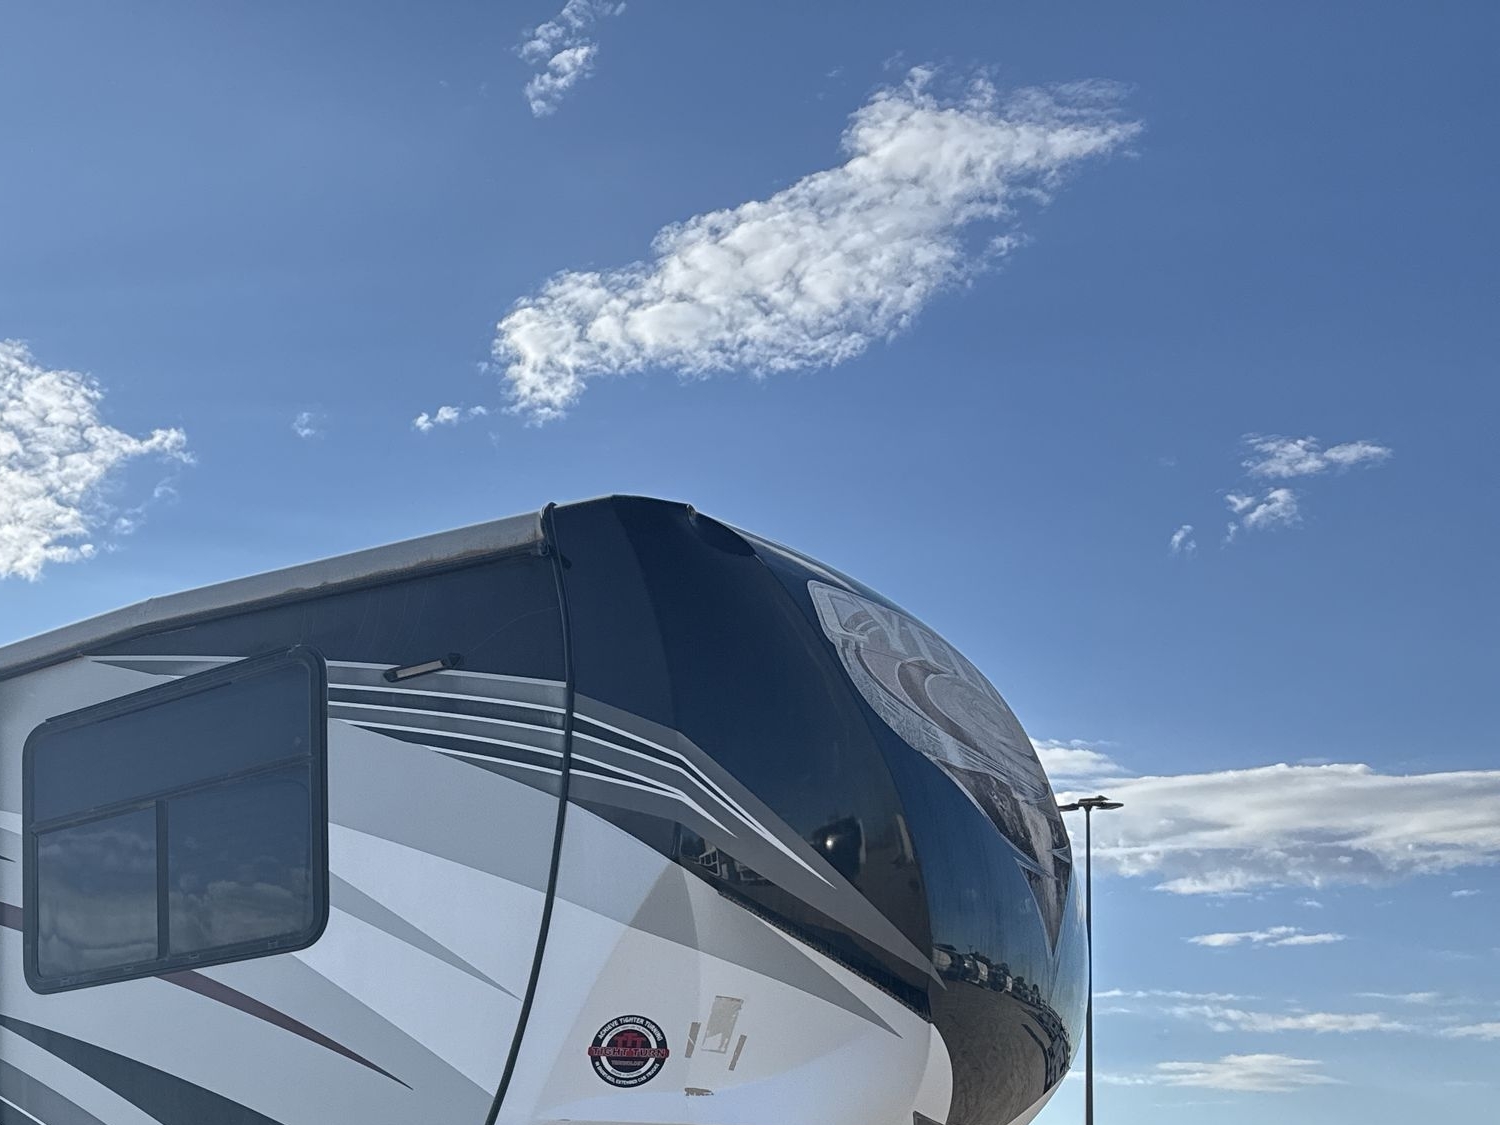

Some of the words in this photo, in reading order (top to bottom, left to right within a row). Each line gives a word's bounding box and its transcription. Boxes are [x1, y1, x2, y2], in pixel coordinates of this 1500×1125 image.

[598, 1020, 619, 1039] ACHIEVE
[619, 1017, 645, 1025] TIGHTER
[644, 1020, 664, 1041] TURNING
[592, 1047, 630, 1057] TIGHT
[632, 1048, 666, 1058] TURN
